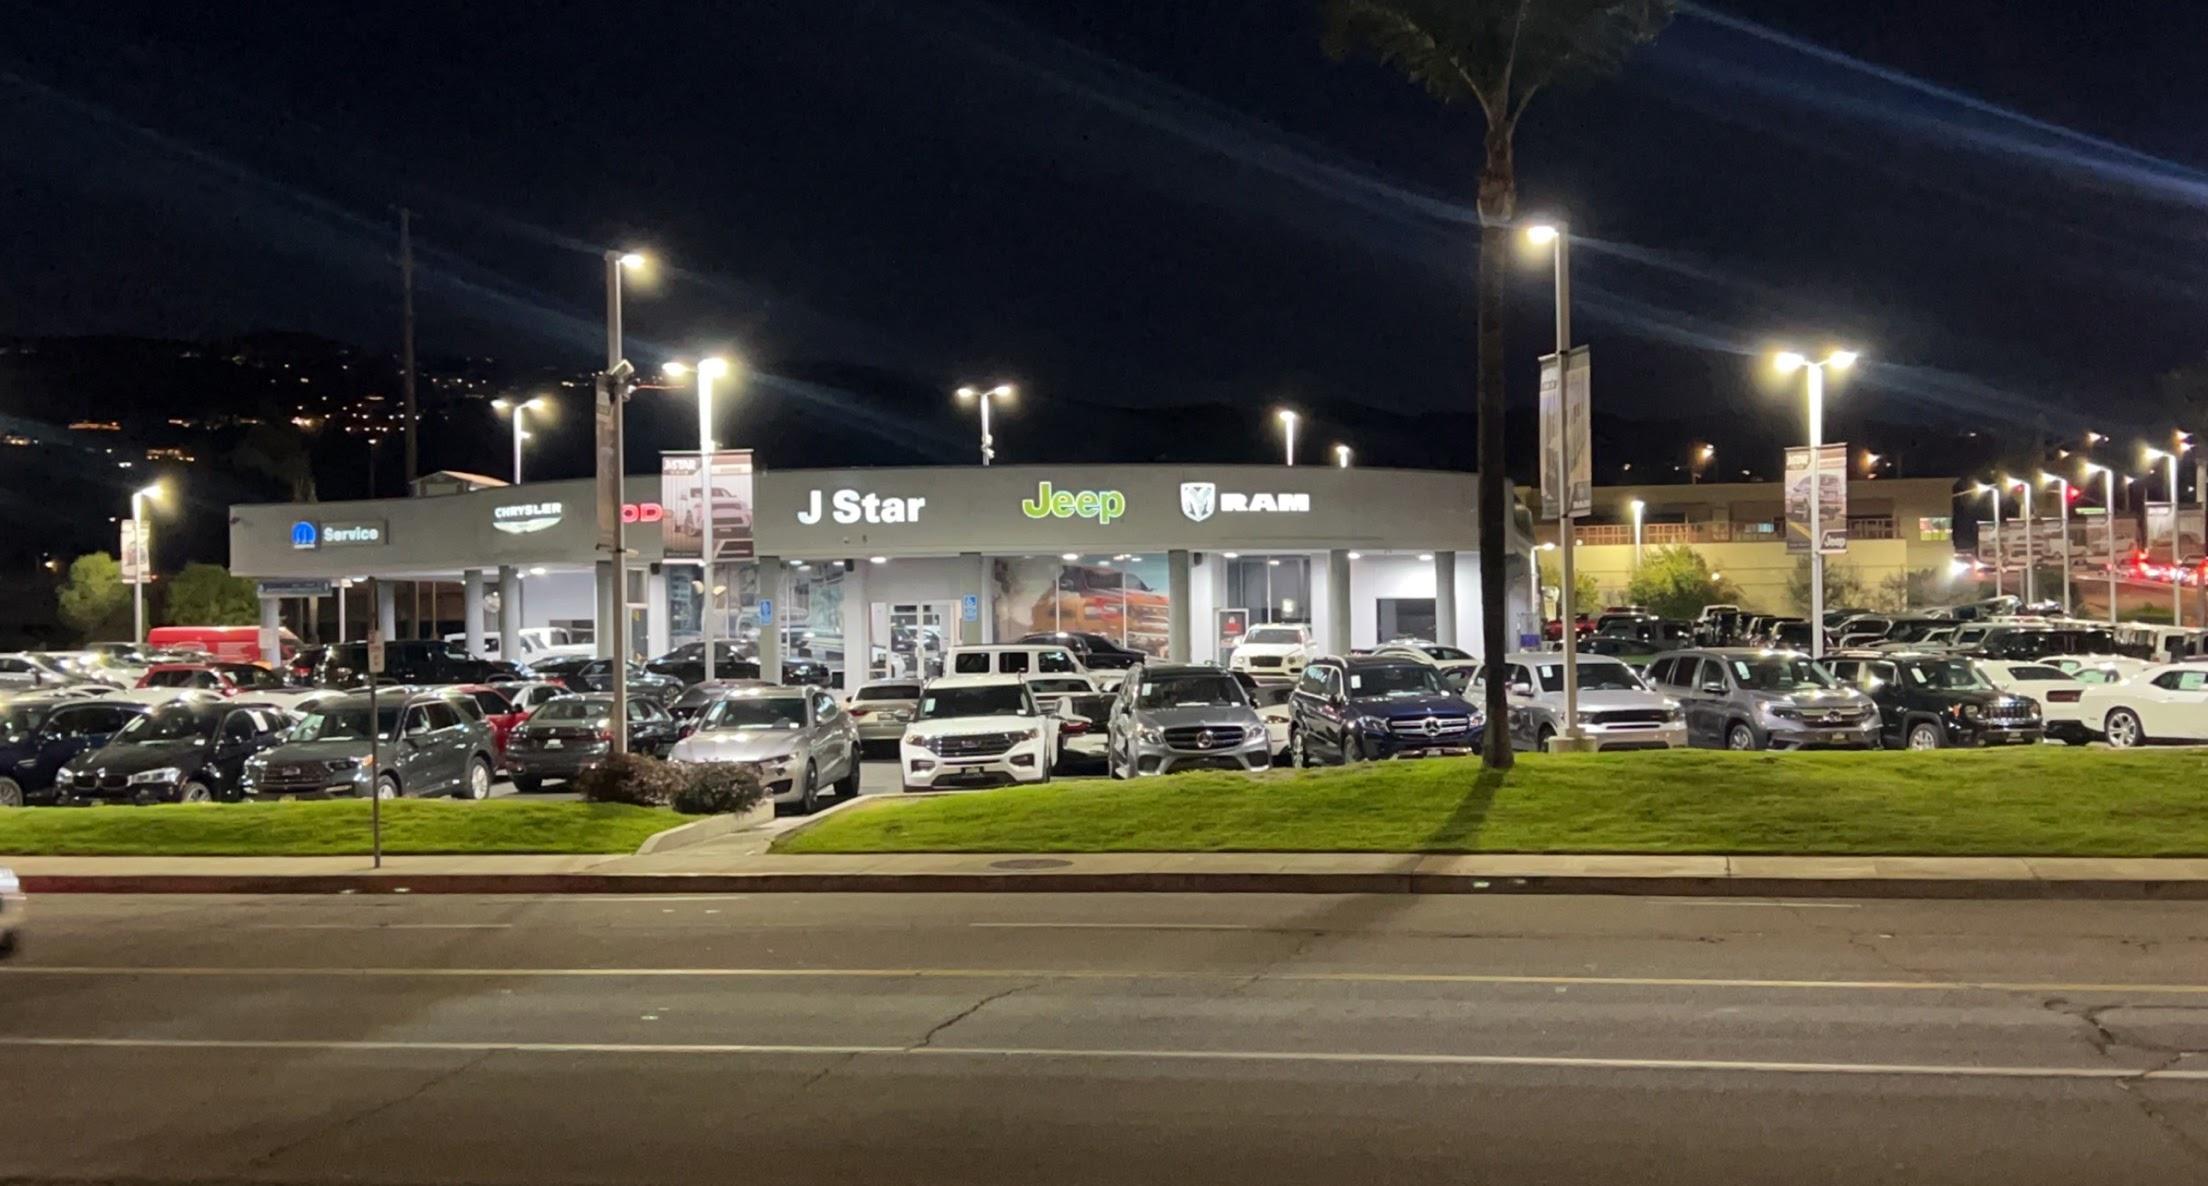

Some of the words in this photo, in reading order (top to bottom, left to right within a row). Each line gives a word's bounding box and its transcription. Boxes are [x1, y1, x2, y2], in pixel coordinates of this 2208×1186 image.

[494, 502, 562, 519] CHRYSLER
[797, 489, 822, 525] J
[832, 489, 926, 524] Star
[1022, 481, 1126, 525] Jeep
[1220, 493, 1310, 512] RAM
[323, 526, 379, 542] Service
